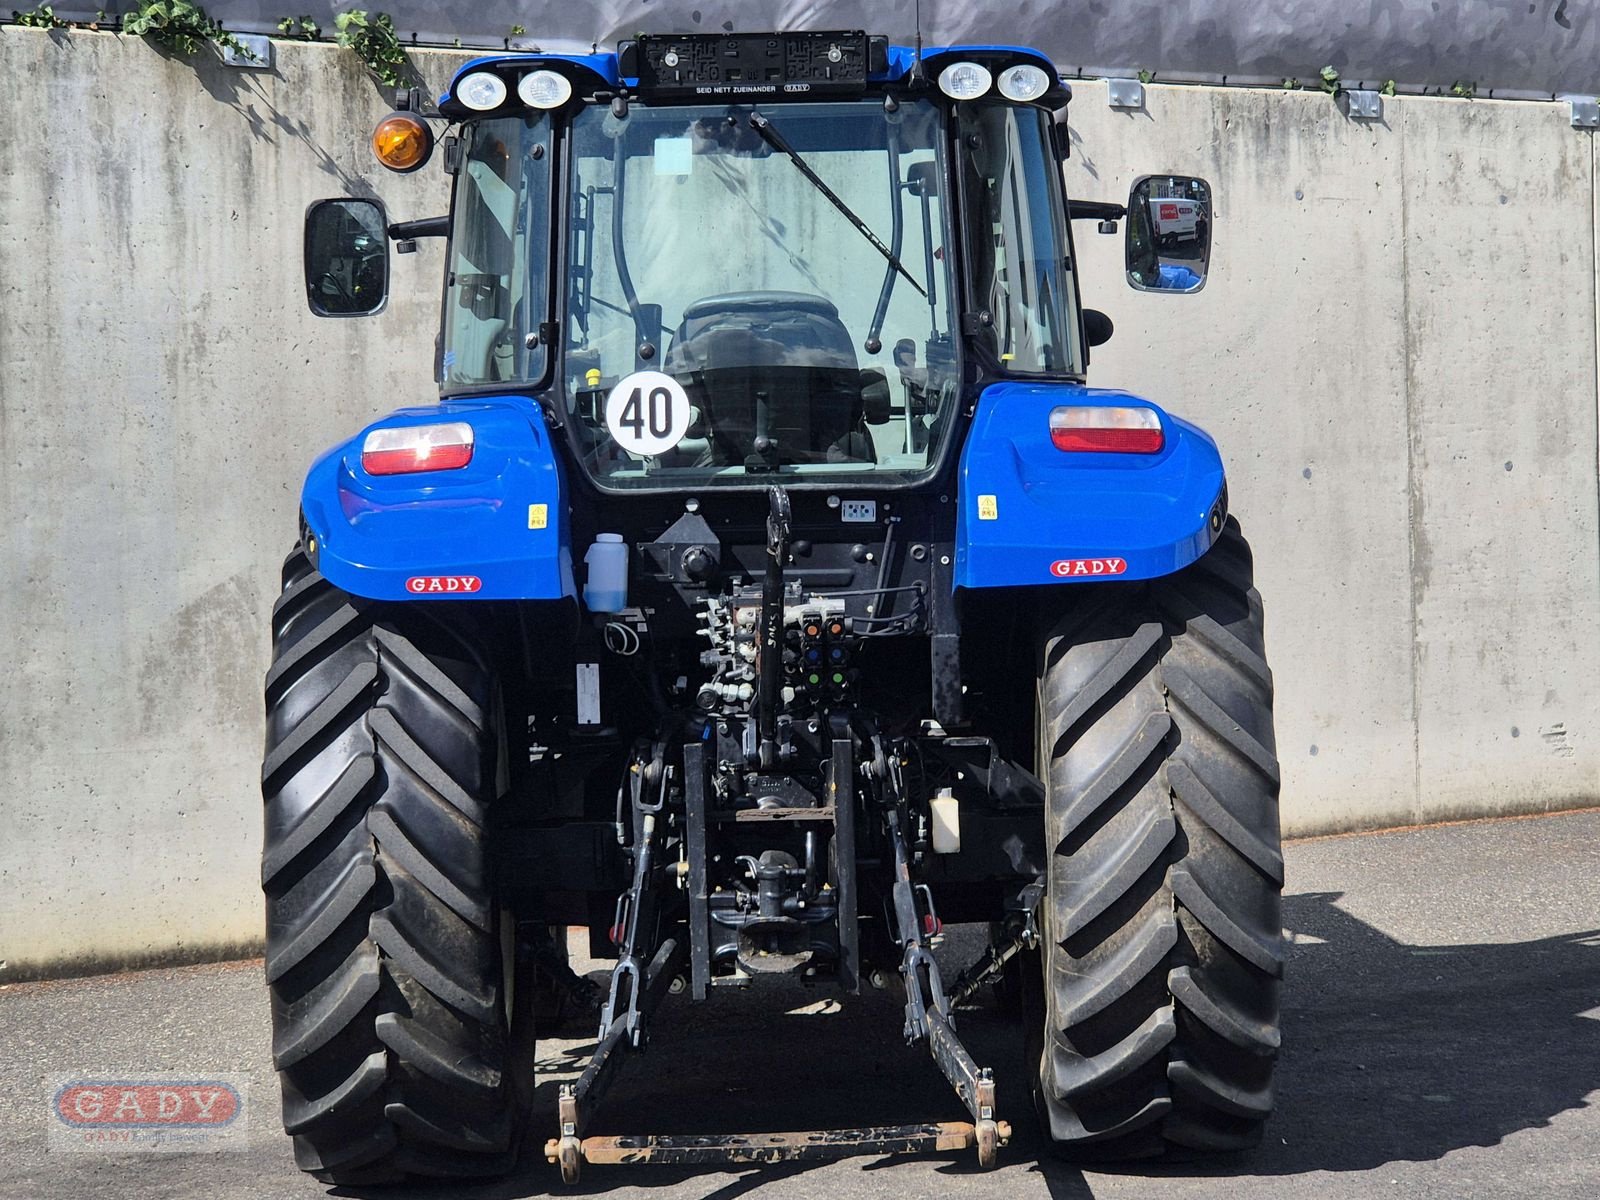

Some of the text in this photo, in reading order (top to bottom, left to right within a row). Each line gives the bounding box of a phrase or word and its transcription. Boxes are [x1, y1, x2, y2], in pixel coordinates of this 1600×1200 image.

[733, 85, 776, 93] ZUEINANDER
[619, 386, 673, 440] 40
[1057, 559, 1120, 575] GADY
[412, 577, 475, 592] GADY
